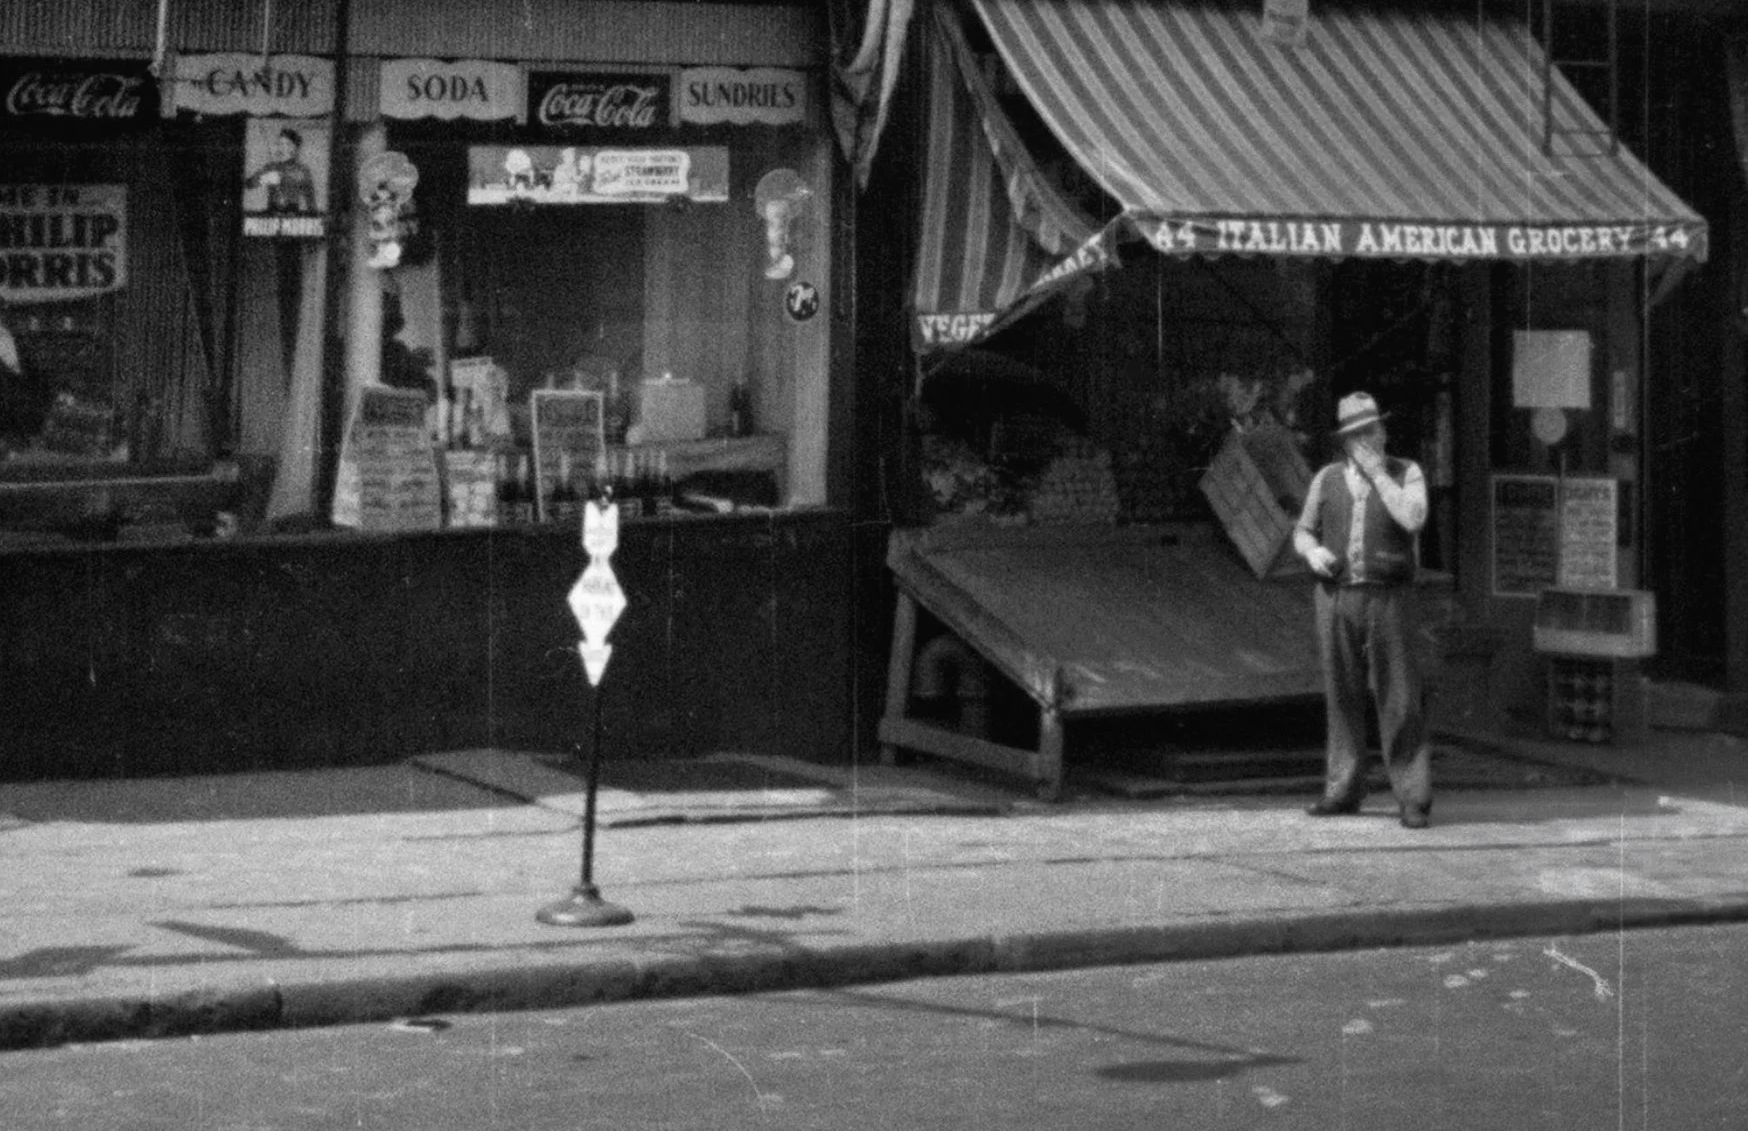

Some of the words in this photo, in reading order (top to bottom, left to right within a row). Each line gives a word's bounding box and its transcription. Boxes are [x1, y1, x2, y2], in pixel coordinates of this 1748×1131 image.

[206, 69, 311, 99] CANDY
[407, 74, 489, 102] SODA
[688, 82, 796, 108] SUNDRIES
[539, 83, 660, 127] Coca-Cola
[1217, 221, 1341, 252] ITALIAN
[1356, 223, 1498, 255] AMERICAN
[1507, 226, 1634, 254] GROCERY
